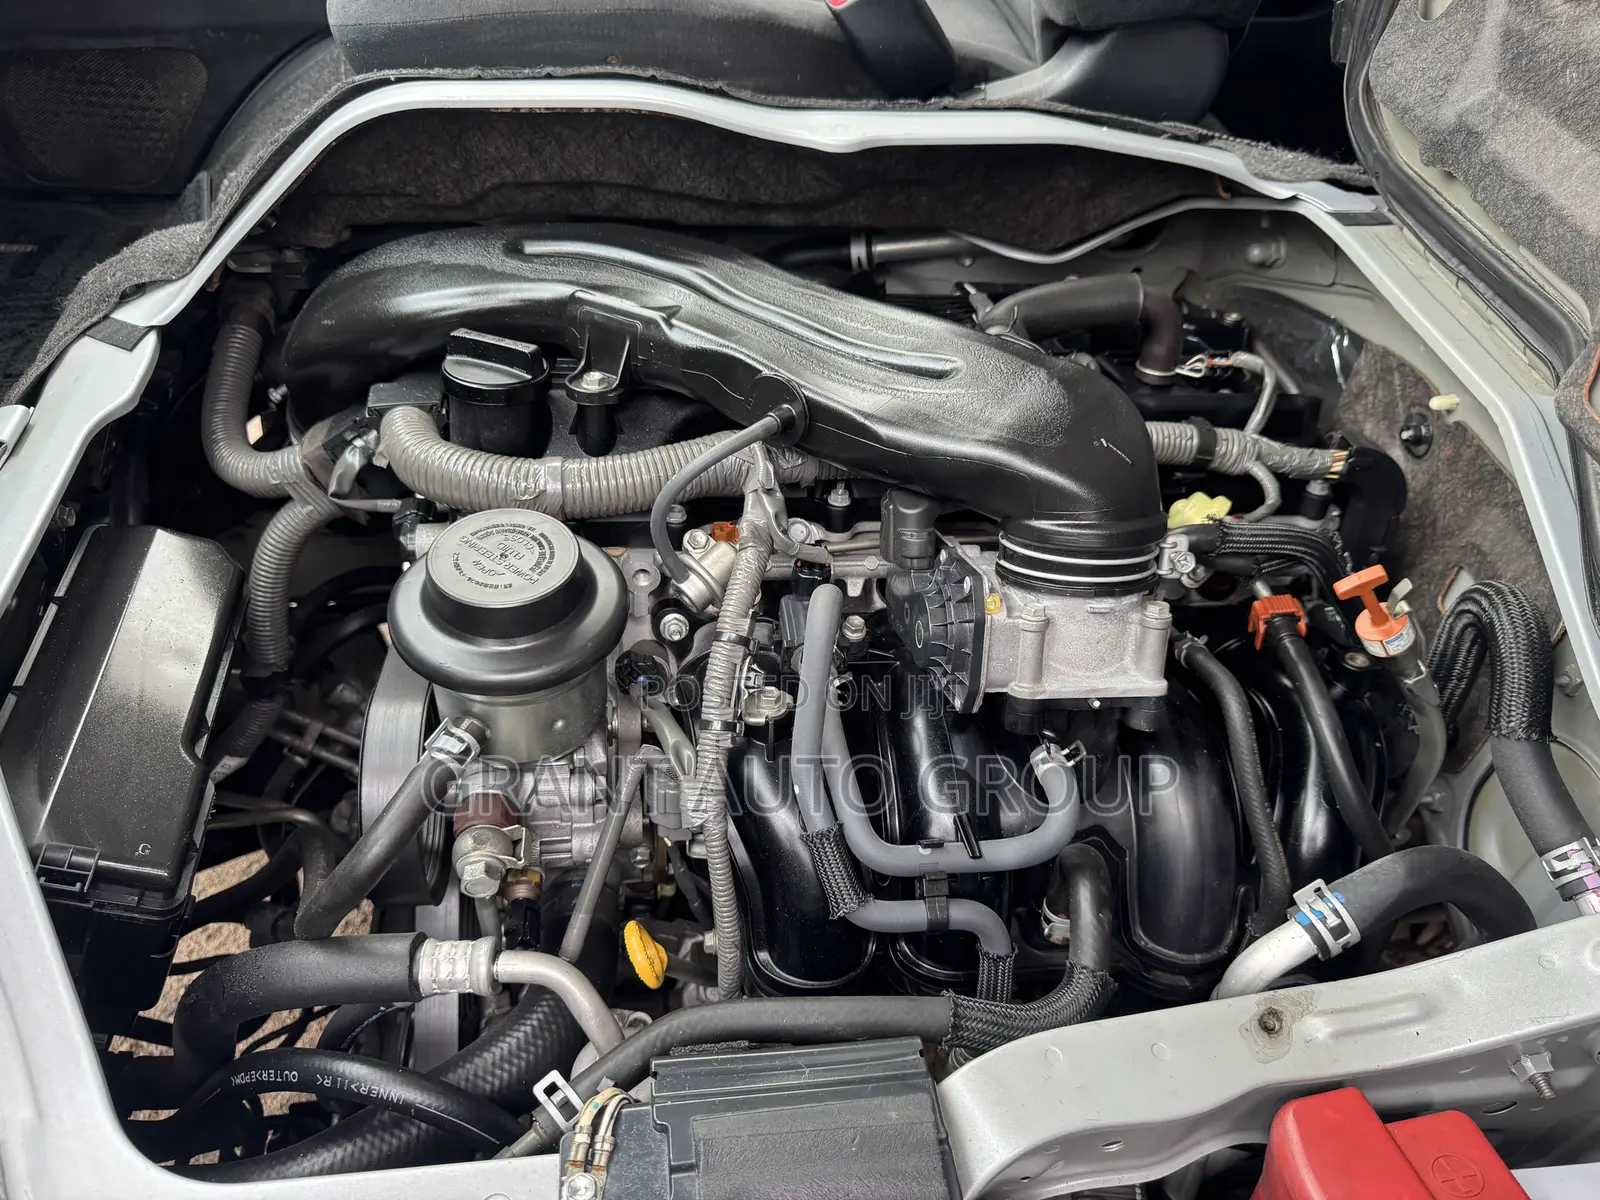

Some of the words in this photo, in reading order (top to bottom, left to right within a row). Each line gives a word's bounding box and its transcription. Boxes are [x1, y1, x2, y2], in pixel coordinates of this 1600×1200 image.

[460, 535, 506, 566] STEERING
[497, 542, 525, 561] FLUID
[502, 534, 533, 552] CLOSE
[472, 559, 497, 577] OPEN
[503, 560, 540, 585] POWER
